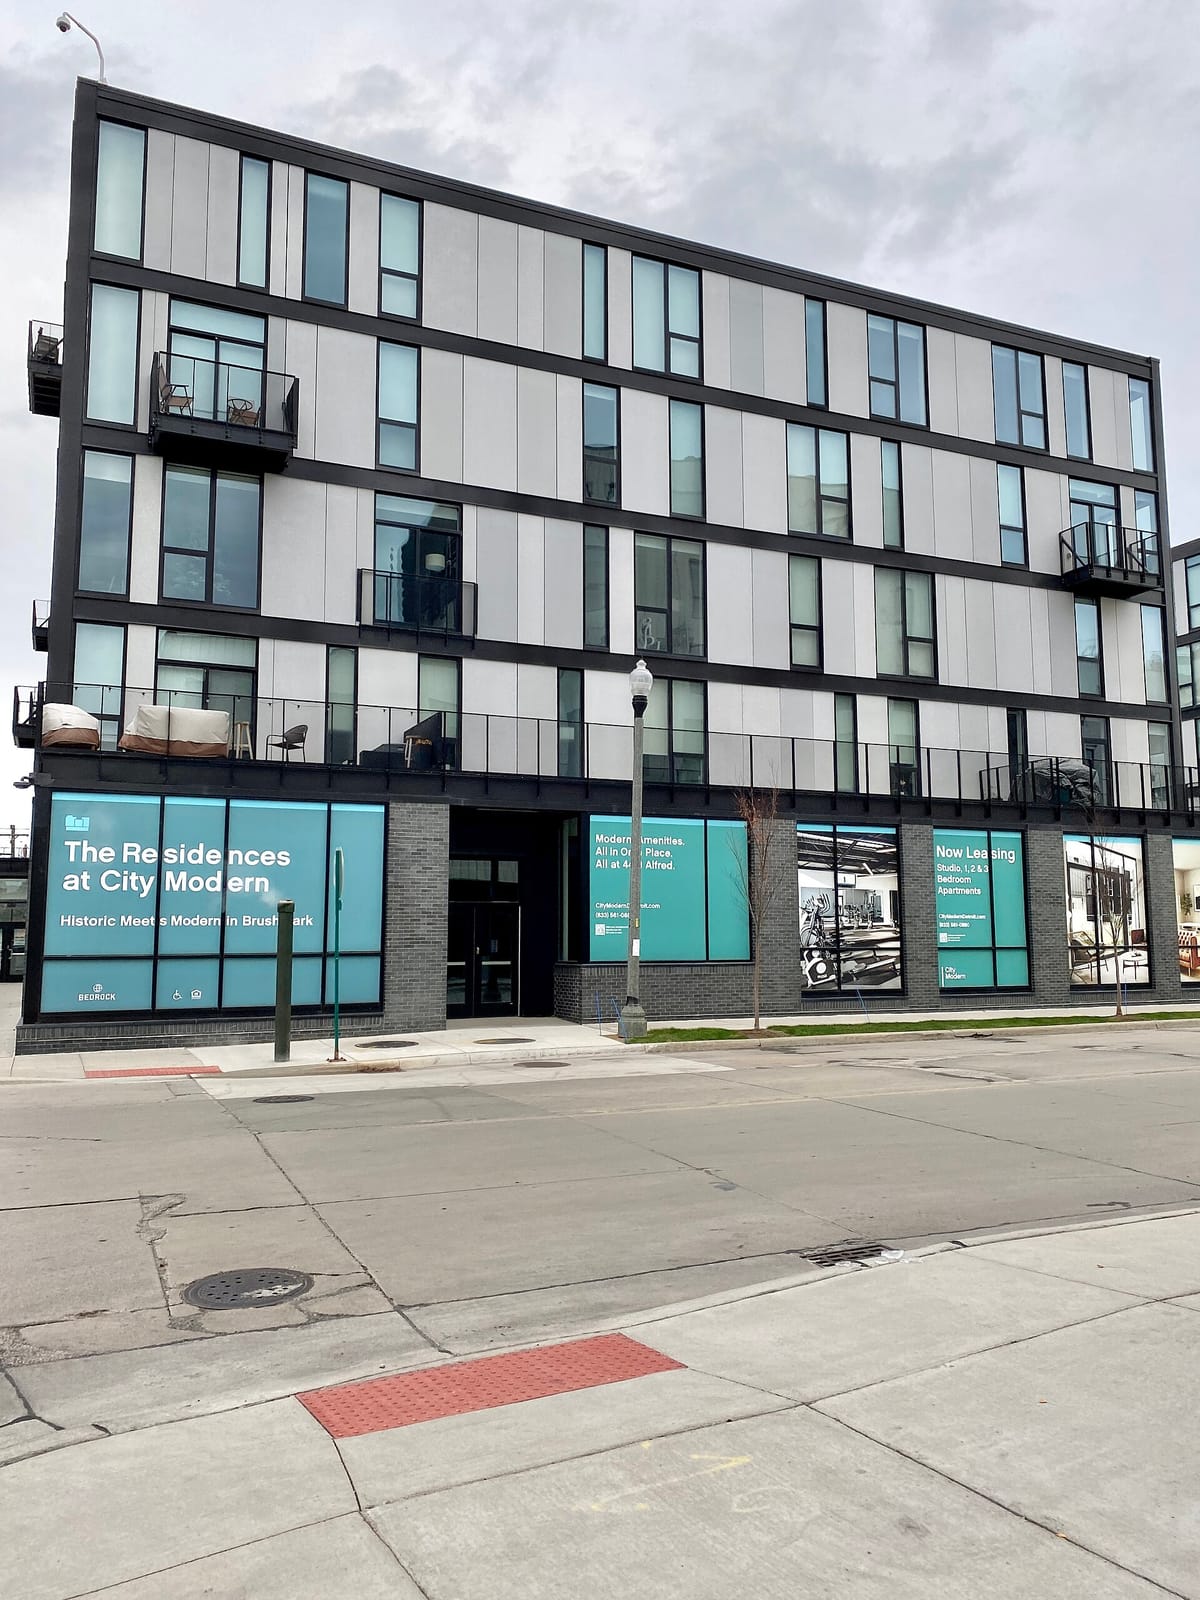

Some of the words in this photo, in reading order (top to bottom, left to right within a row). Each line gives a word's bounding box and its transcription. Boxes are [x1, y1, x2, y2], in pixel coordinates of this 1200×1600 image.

[595, 833, 632, 844] Modern
[64, 840, 116, 863] The
[122, 842, 291, 867] Residences
[595, 846, 608, 857] All
[645, 848, 673, 858] Place.
[936, 845, 963, 858] Now
[966, 846, 1015, 864] Leasing
[595, 858, 608, 869] All
[610, 859, 620, 869] at
[645, 860, 676, 870] Alfred.
[937, 863, 963, 874] Studio,
[970, 864, 976, 873] 2
[976, 864, 983, 873] &
[983, 865, 989, 873] 3
[62, 870, 91, 891] at
[100, 869, 155, 898] City
[165, 870, 270, 893] Modern
[937, 875, 972, 884] Bedroom
[938, 886, 982, 896] Apartments
[60, 914, 116, 927] Historic
[120, 914, 168, 927] Meets
[171, 914, 221, 927] Modern
[226, 915, 238, 927] in
[242, 915, 279, 927] Brush
[292, 914, 313, 927] ark
[944, 966, 956, 974] City
[78, 993, 116, 1001] BEDROCK
